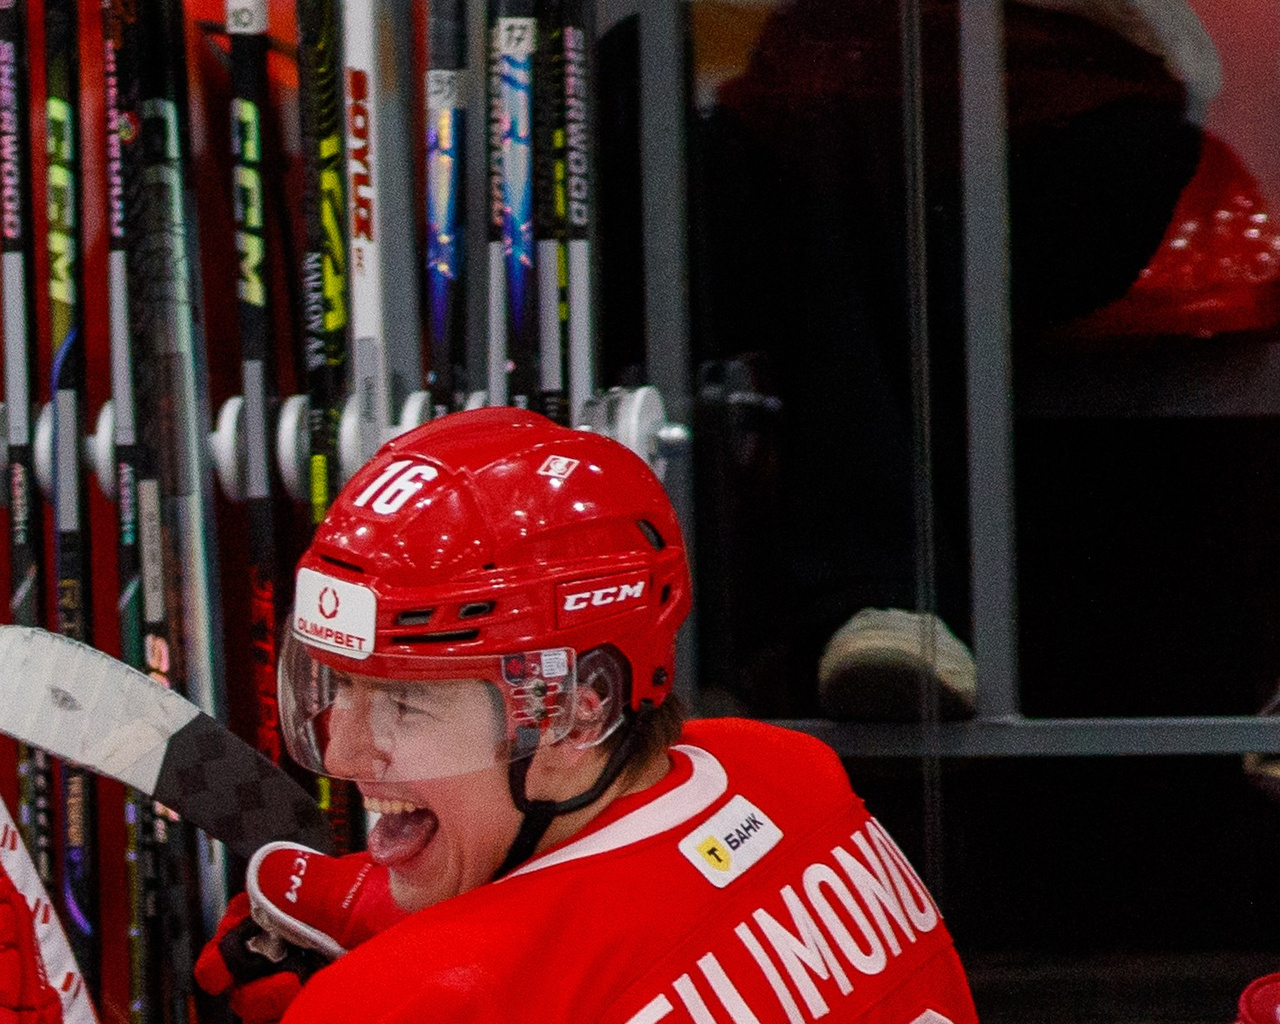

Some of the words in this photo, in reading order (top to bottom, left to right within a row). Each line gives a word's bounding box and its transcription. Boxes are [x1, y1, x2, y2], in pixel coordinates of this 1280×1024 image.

[565, 26, 589, 227] SHERWOOD
[46, 96, 76, 305] CCM
[231, 97, 266, 307] CCM
[353, 459, 439, 515] 16
[563, 581, 645, 612] CCM
[297, 616, 366, 652] OLIMPBET
[723, 812, 765, 852] БАНК
